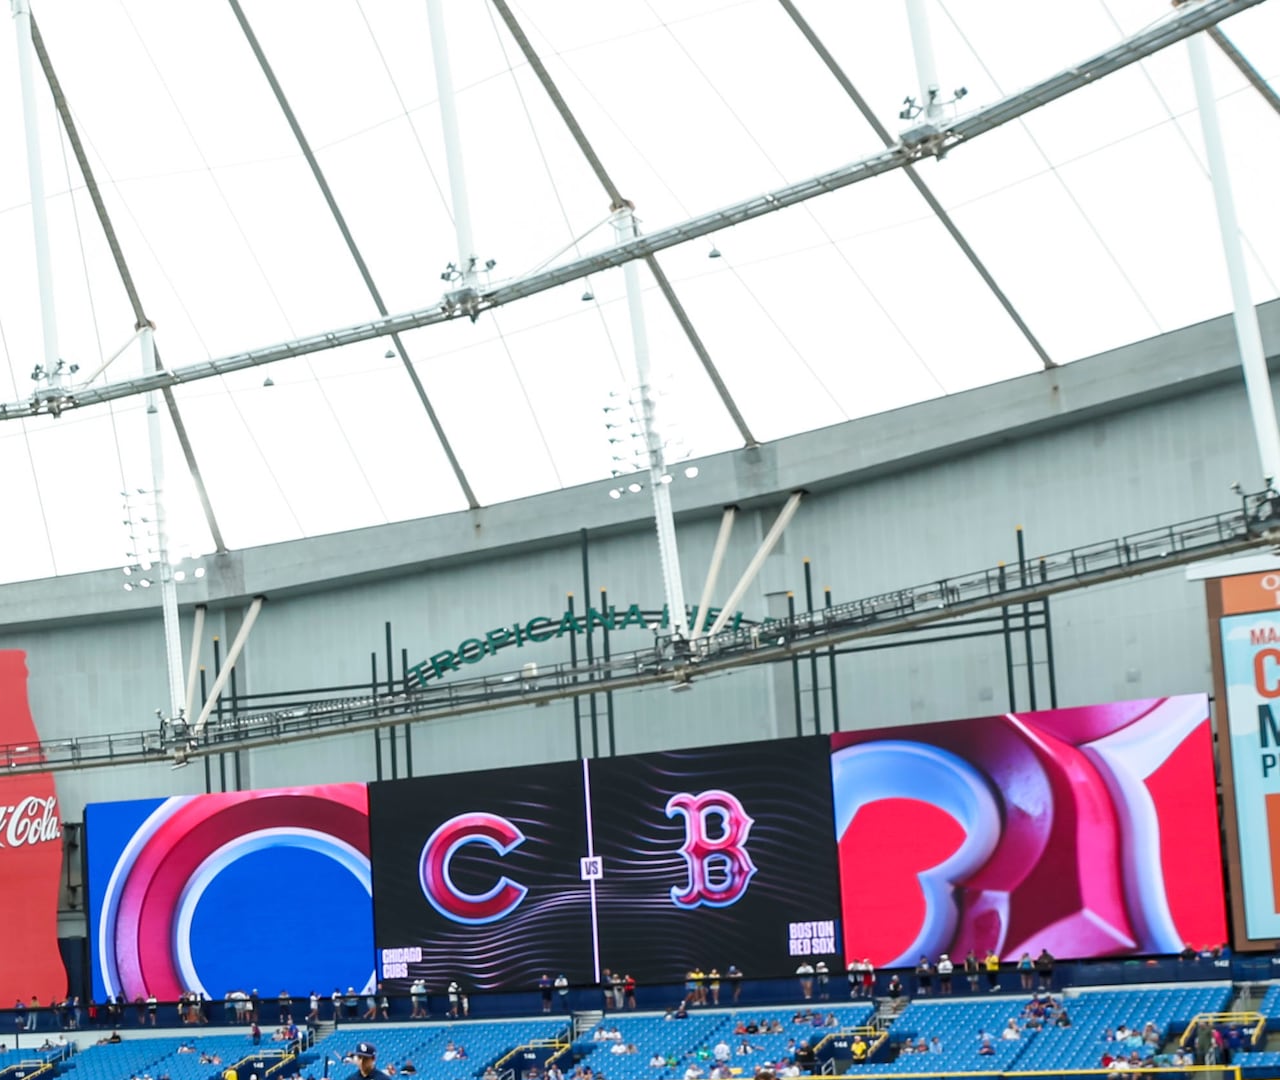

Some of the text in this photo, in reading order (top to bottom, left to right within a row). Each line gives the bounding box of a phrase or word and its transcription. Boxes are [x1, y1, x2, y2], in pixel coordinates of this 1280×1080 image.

[406, 603, 648, 688] TROPICANA
[585, 860, 599, 875] VS
[789, 920, 835, 939] BOSTON
[382, 947, 422, 963] CHICAGO
[789, 937, 836, 956] RED SOX
[383, 963, 408, 979] CUBS
